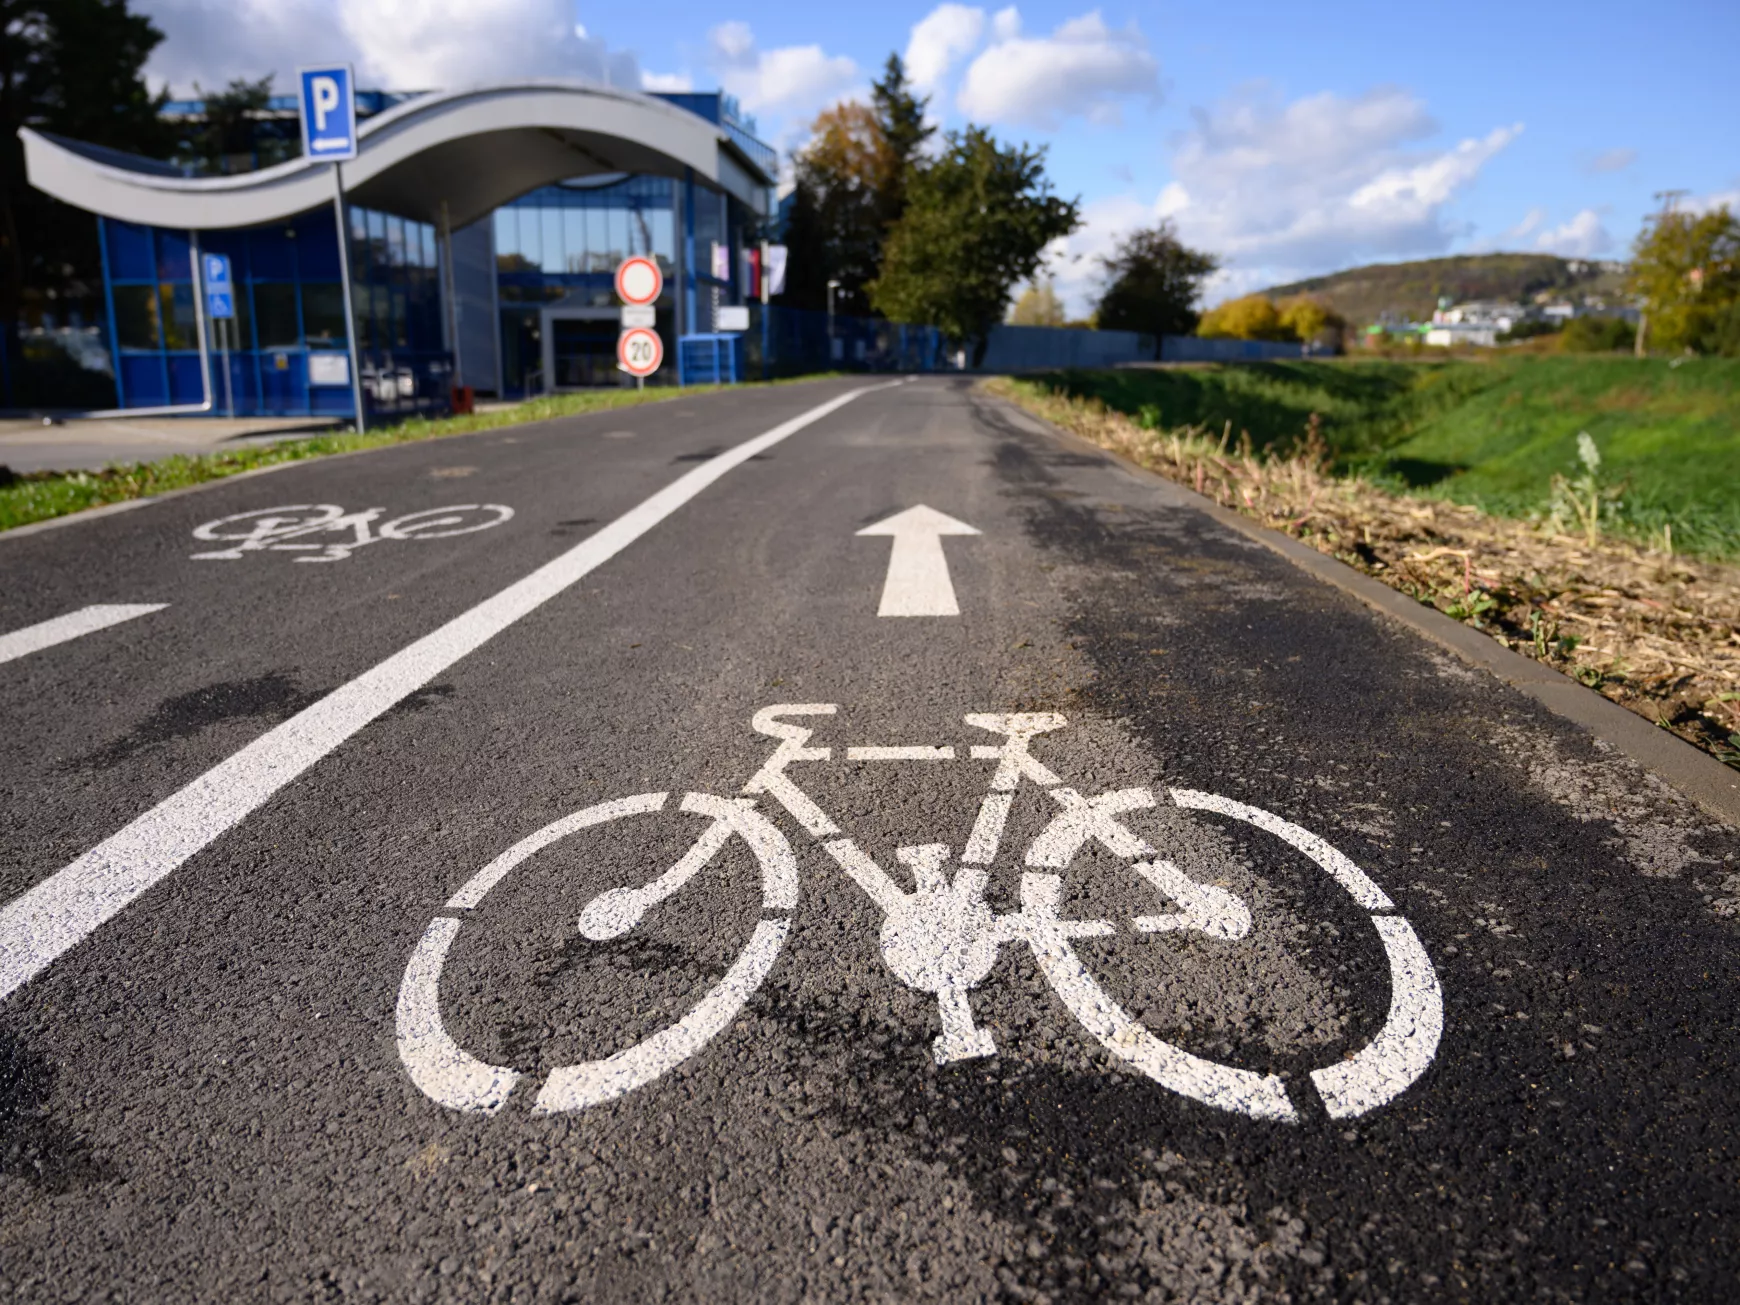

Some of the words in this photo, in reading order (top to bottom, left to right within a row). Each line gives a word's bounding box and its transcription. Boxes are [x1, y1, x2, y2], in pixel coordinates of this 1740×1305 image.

[311, 76, 339, 131] P
[210, 258, 224, 280] P
[631, 341, 652, 361] 20
